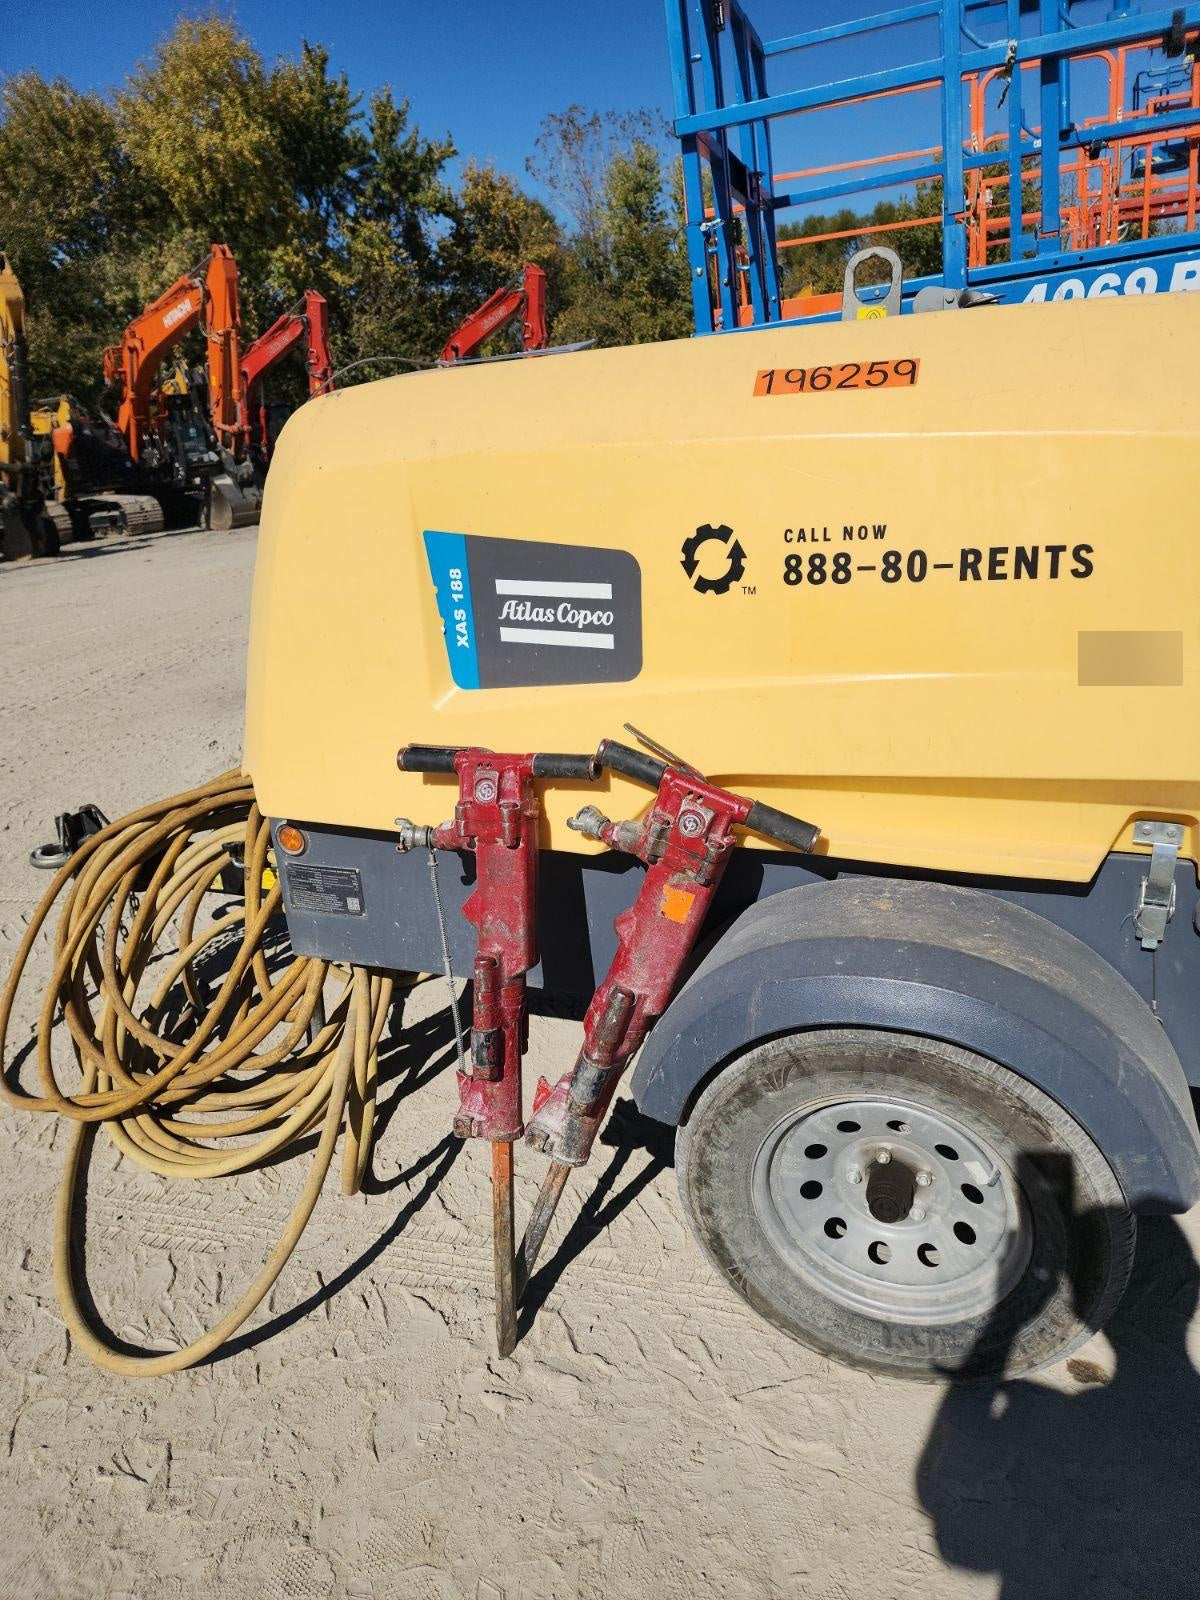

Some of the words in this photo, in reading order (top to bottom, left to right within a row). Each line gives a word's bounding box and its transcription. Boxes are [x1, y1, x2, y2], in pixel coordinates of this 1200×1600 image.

[761, 358, 917, 394] 196259
[784, 527, 831, 543] CALL
[843, 525, 887, 541] NOW
[783, 544, 1094, 586] 888-80-RENTS
[449, 568, 464, 602] 188
[741, 586, 757, 595] TM
[454, 609, 470, 649] XAS
[498, 600, 555, 622] Atlas
[557, 602, 614, 629] Copco
